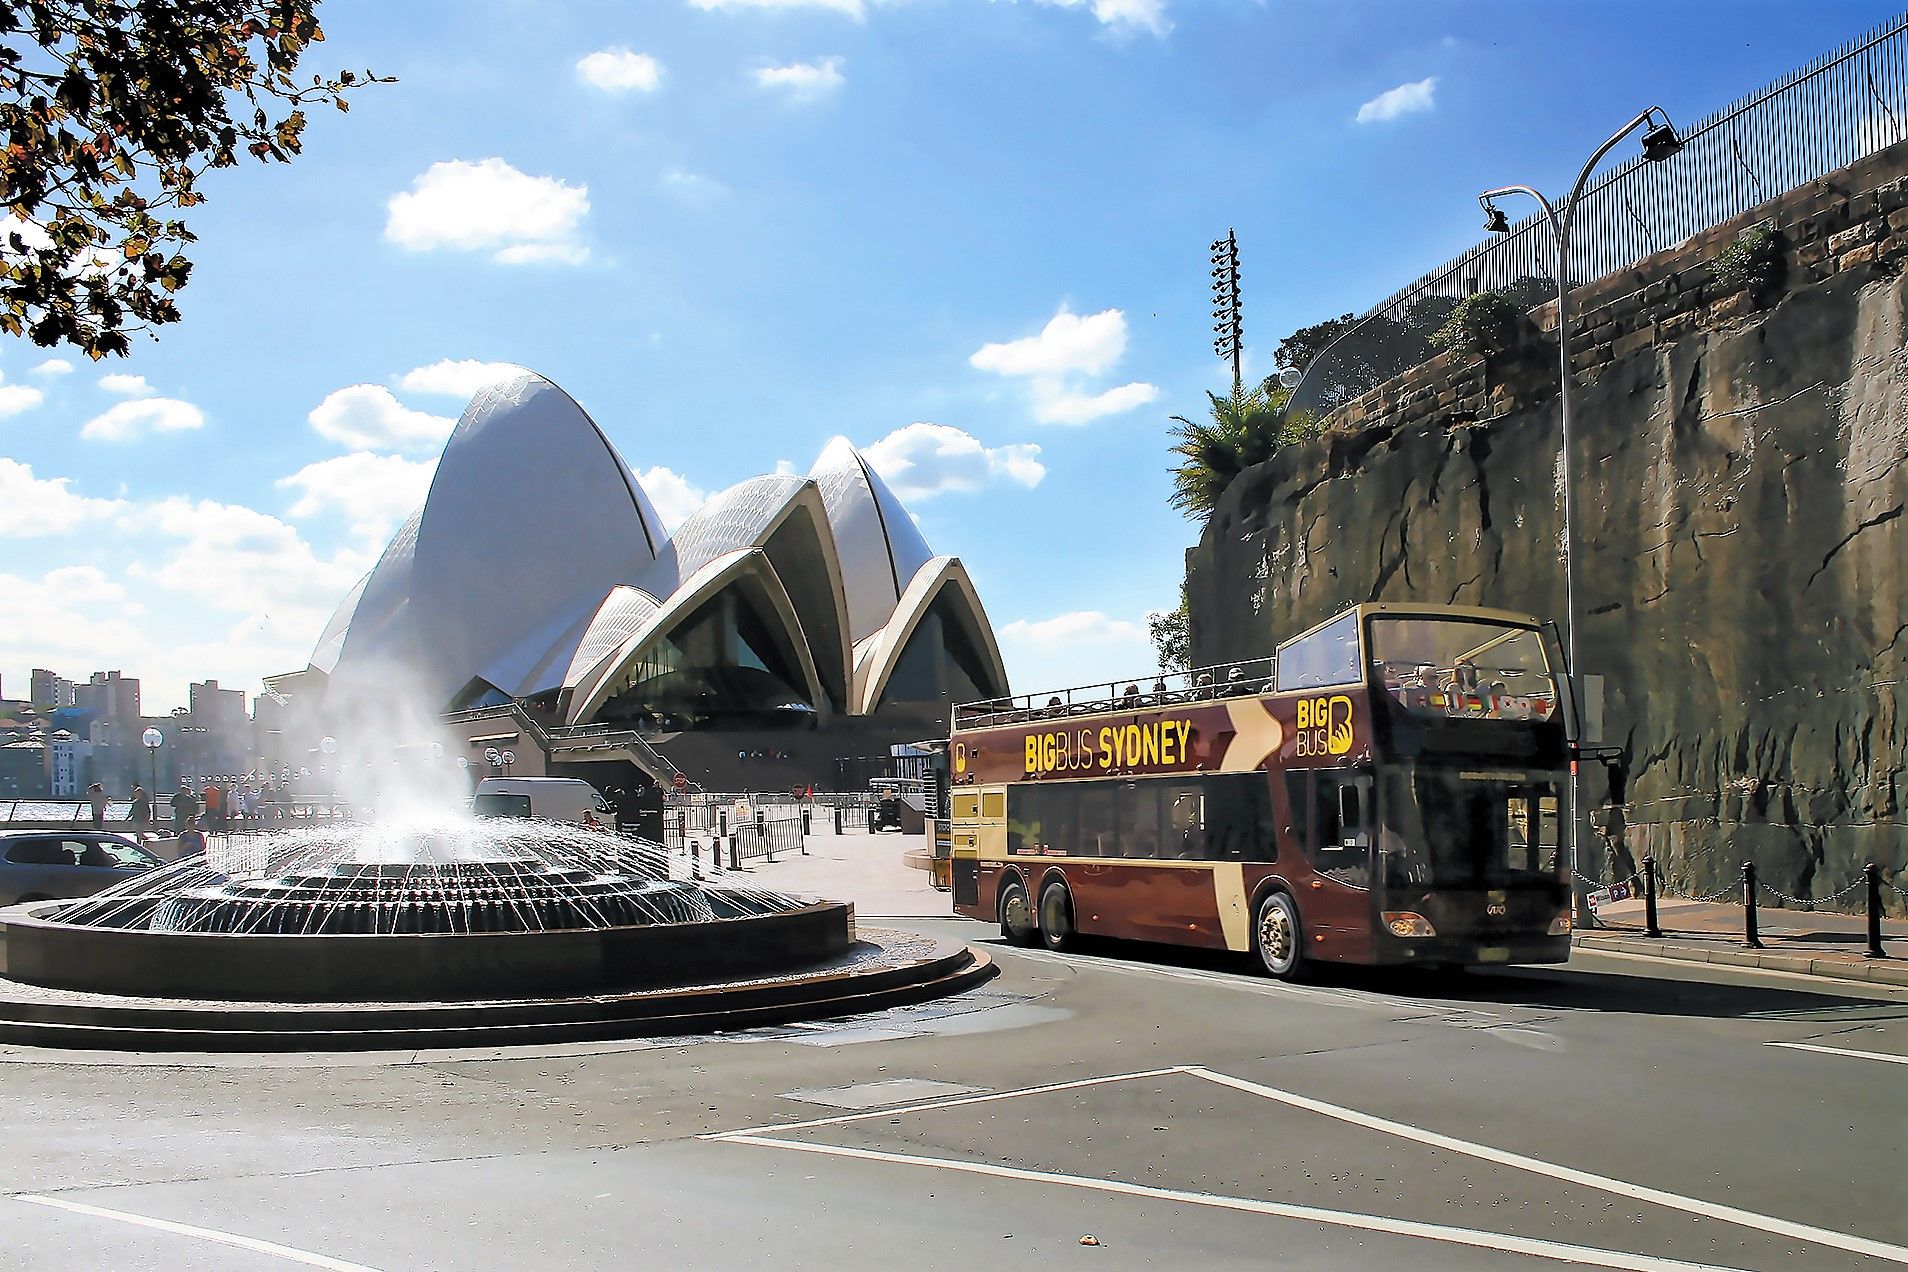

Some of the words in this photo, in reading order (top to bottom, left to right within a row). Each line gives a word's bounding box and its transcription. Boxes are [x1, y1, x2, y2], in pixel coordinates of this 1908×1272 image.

[1297, 697, 1327, 729] BIG
[1099, 719, 1191, 769] SYDNEY
[1296, 729, 1328, 757] BUS
